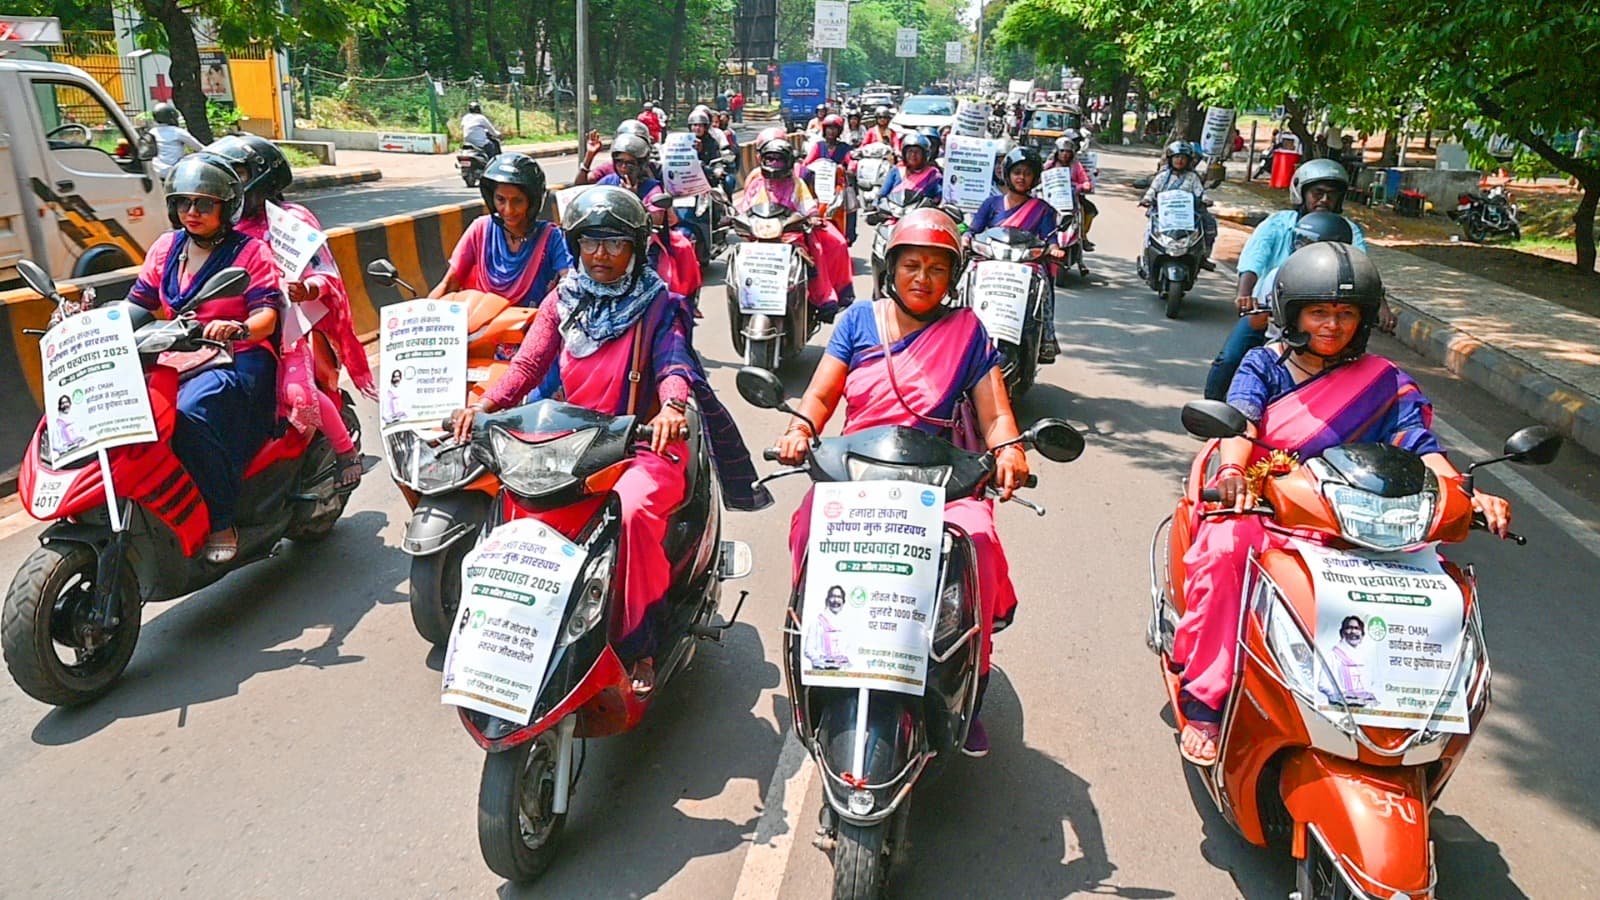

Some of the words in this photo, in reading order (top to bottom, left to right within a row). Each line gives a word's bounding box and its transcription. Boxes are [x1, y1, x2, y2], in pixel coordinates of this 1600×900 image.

[438, 337, 460, 346] 2025
[103, 346, 128, 358] 2025
[820, 538, 850, 554] पोषण
[904, 544, 932, 560] 2025
[531, 577, 562, 594] 2025
[1322, 570, 1358, 586] पोषण
[1412, 578, 1448, 590] 2025
[894, 610, 911, 620] 1000
